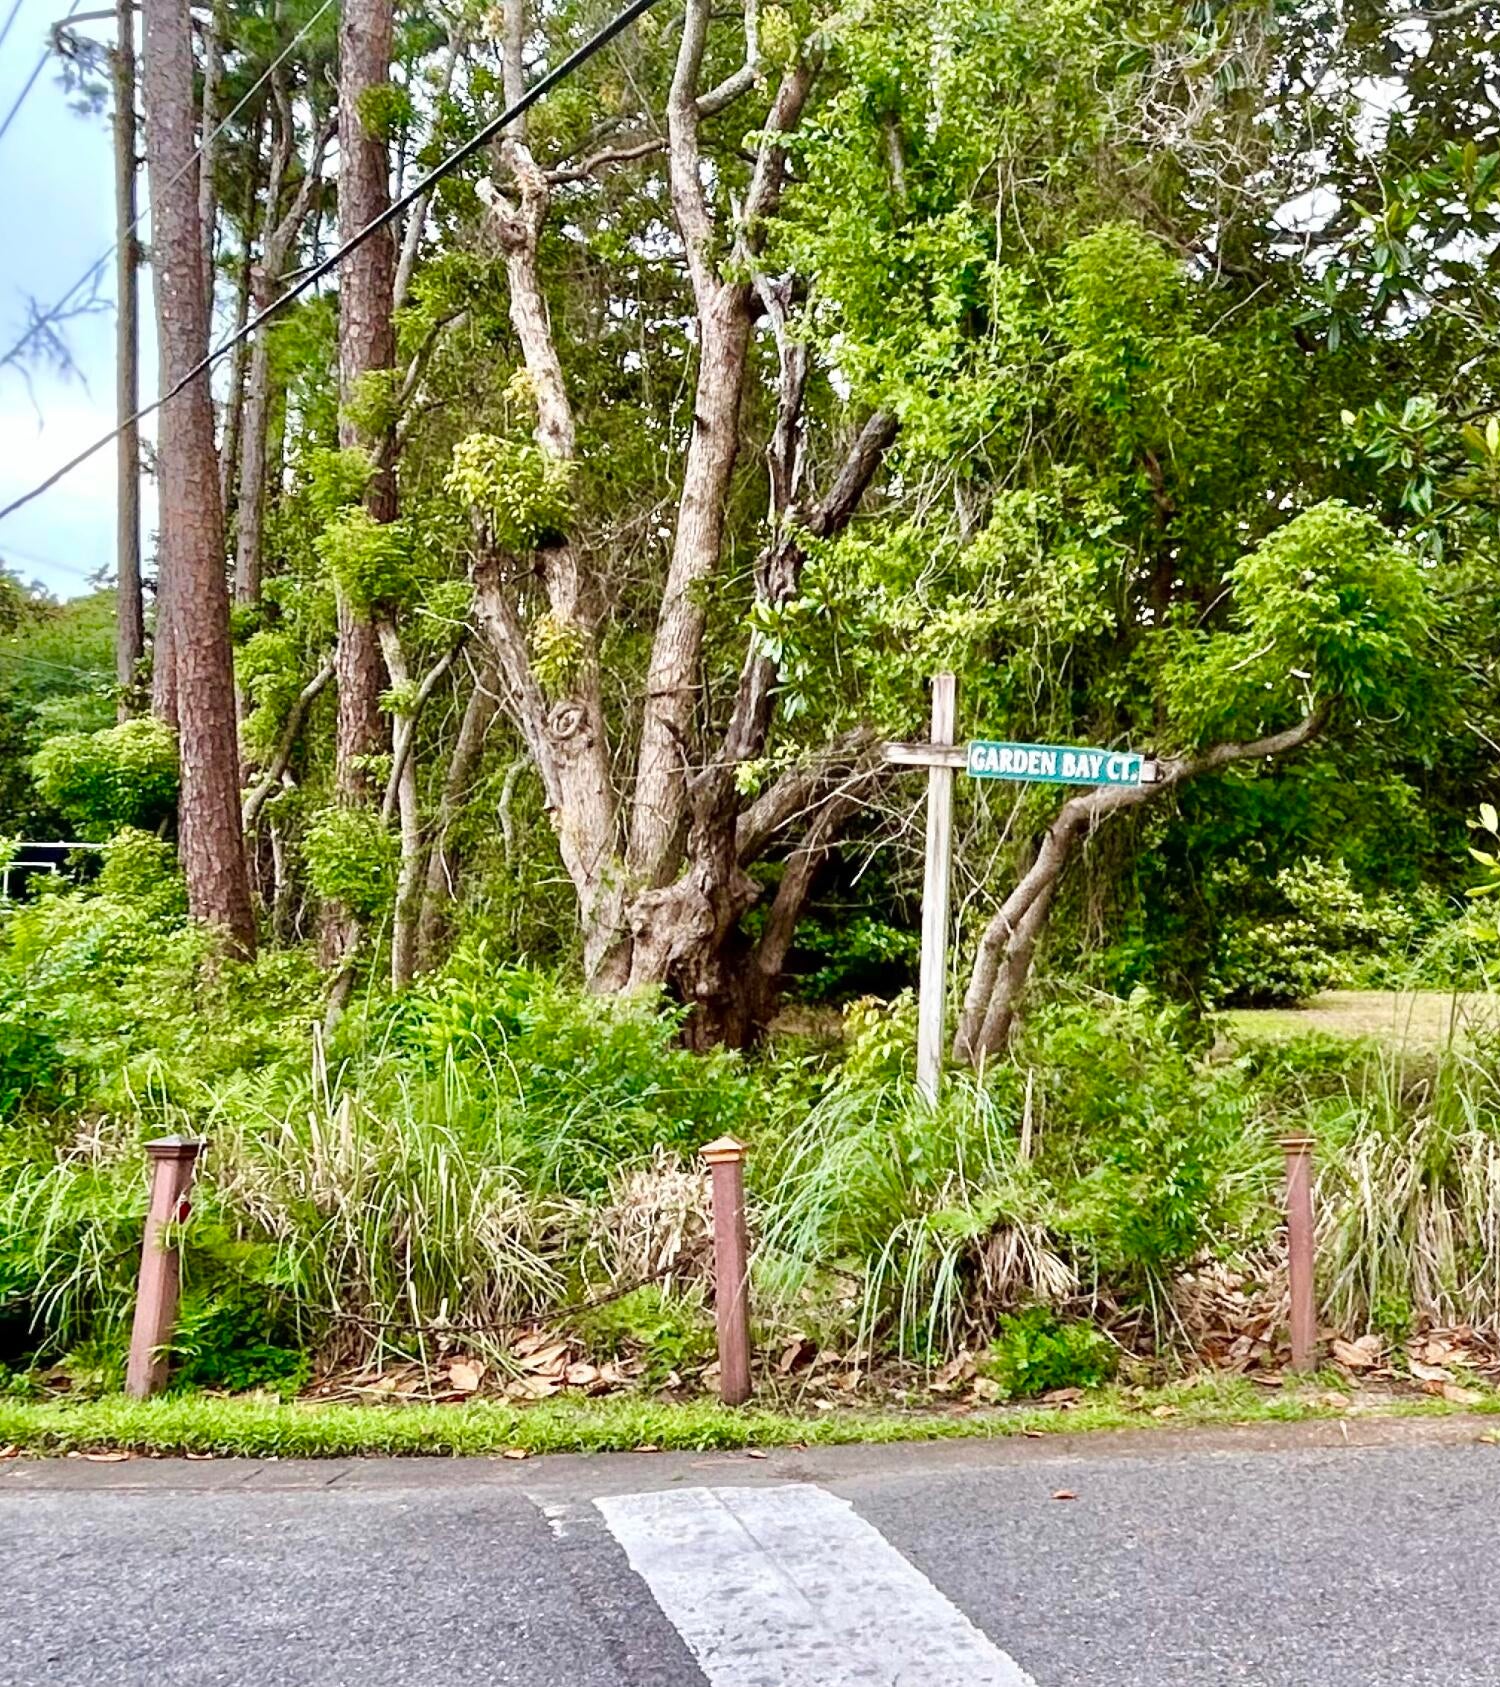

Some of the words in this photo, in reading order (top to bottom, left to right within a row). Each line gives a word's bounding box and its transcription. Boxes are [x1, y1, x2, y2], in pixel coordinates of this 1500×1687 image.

[970, 746, 1057, 776] GARDEN
[1062, 753, 1104, 779] BAY
[1106, 756, 1138, 782] CT.
